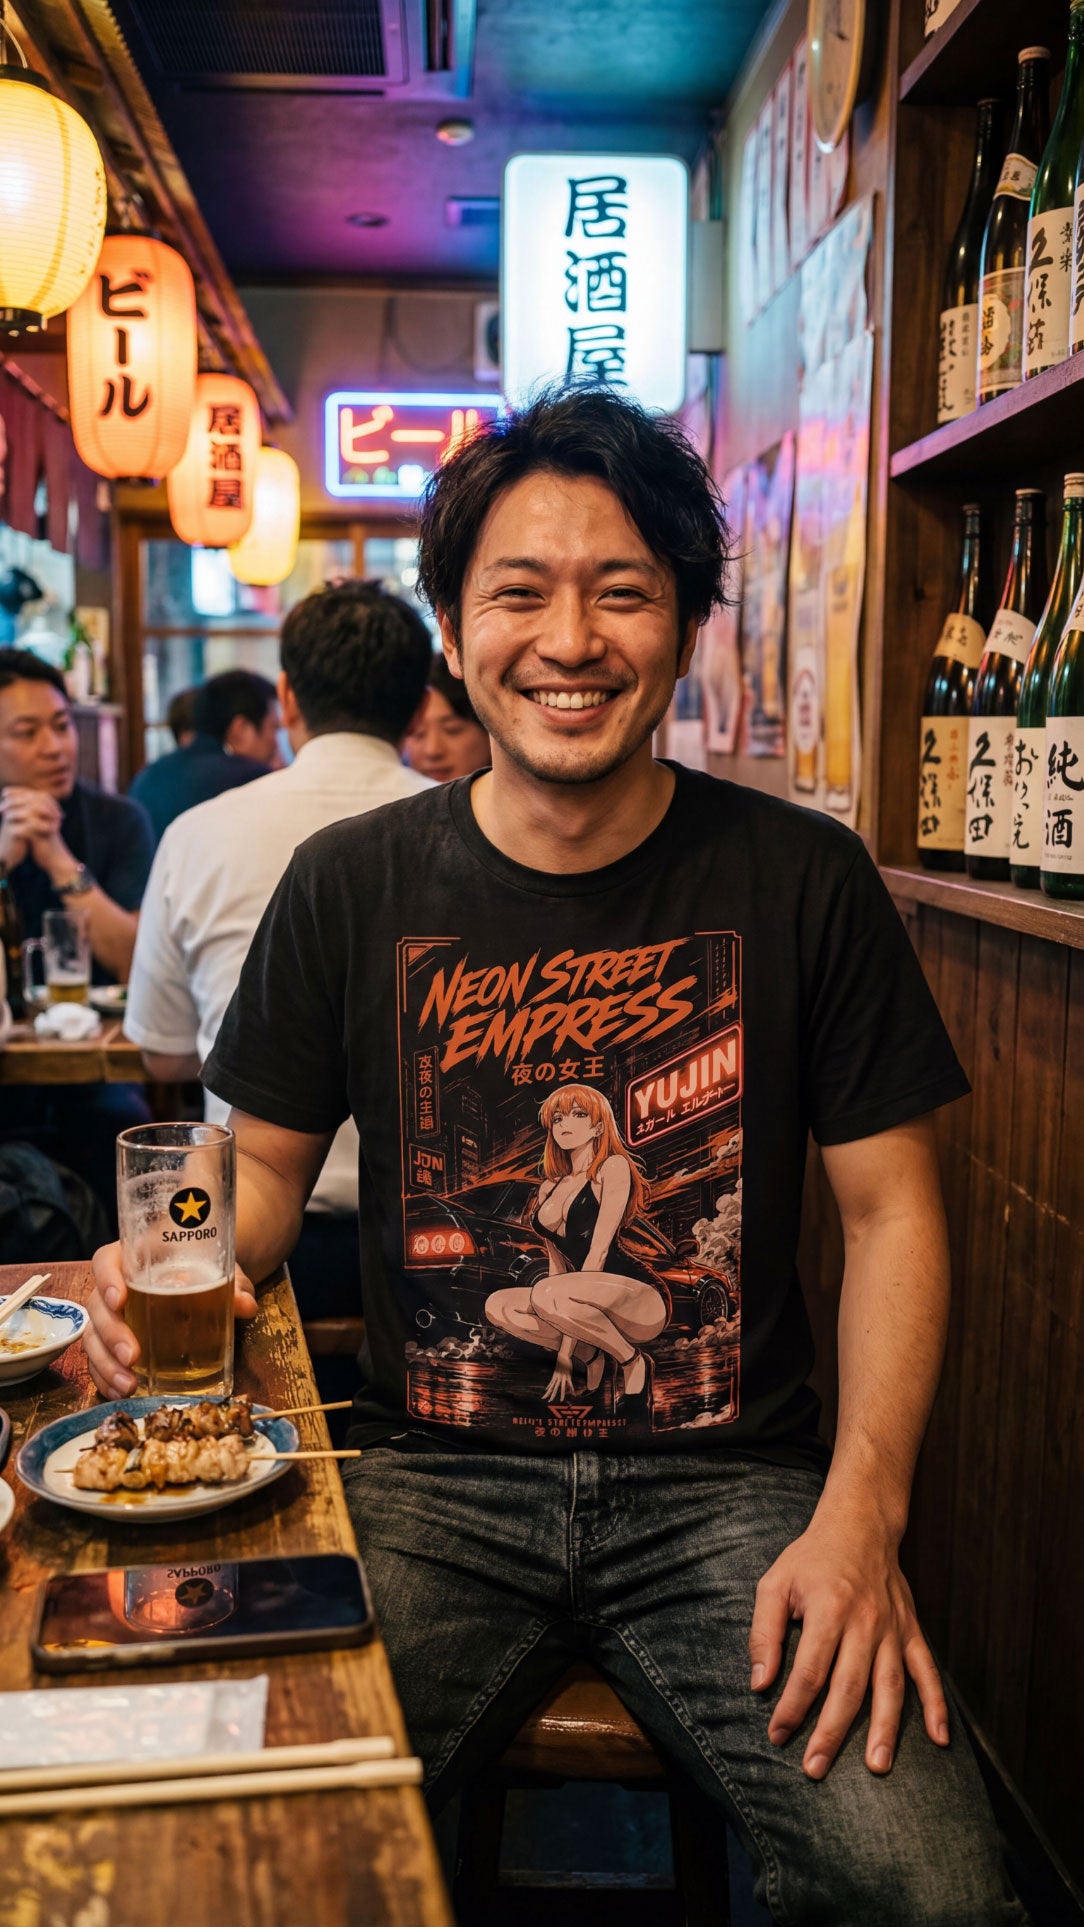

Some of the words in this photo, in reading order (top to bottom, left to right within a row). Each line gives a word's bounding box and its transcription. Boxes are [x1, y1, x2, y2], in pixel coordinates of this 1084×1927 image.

[565, 175, 628, 386] 居酒屋
[100, 271, 149, 417] ビール
[209, 406, 241, 509] 居酒屋
[968, 731, 996, 842] 久保田
[419, 948, 541, 1034] NEON
[520, 938, 692, 1006] STREET
[440, 975, 698, 1076] EMPRESS
[512, 1055, 605, 1087] 夜の女王
[634, 1039, 736, 1119] YUJIN
[162, 1226, 217, 1242] SAPPORO
